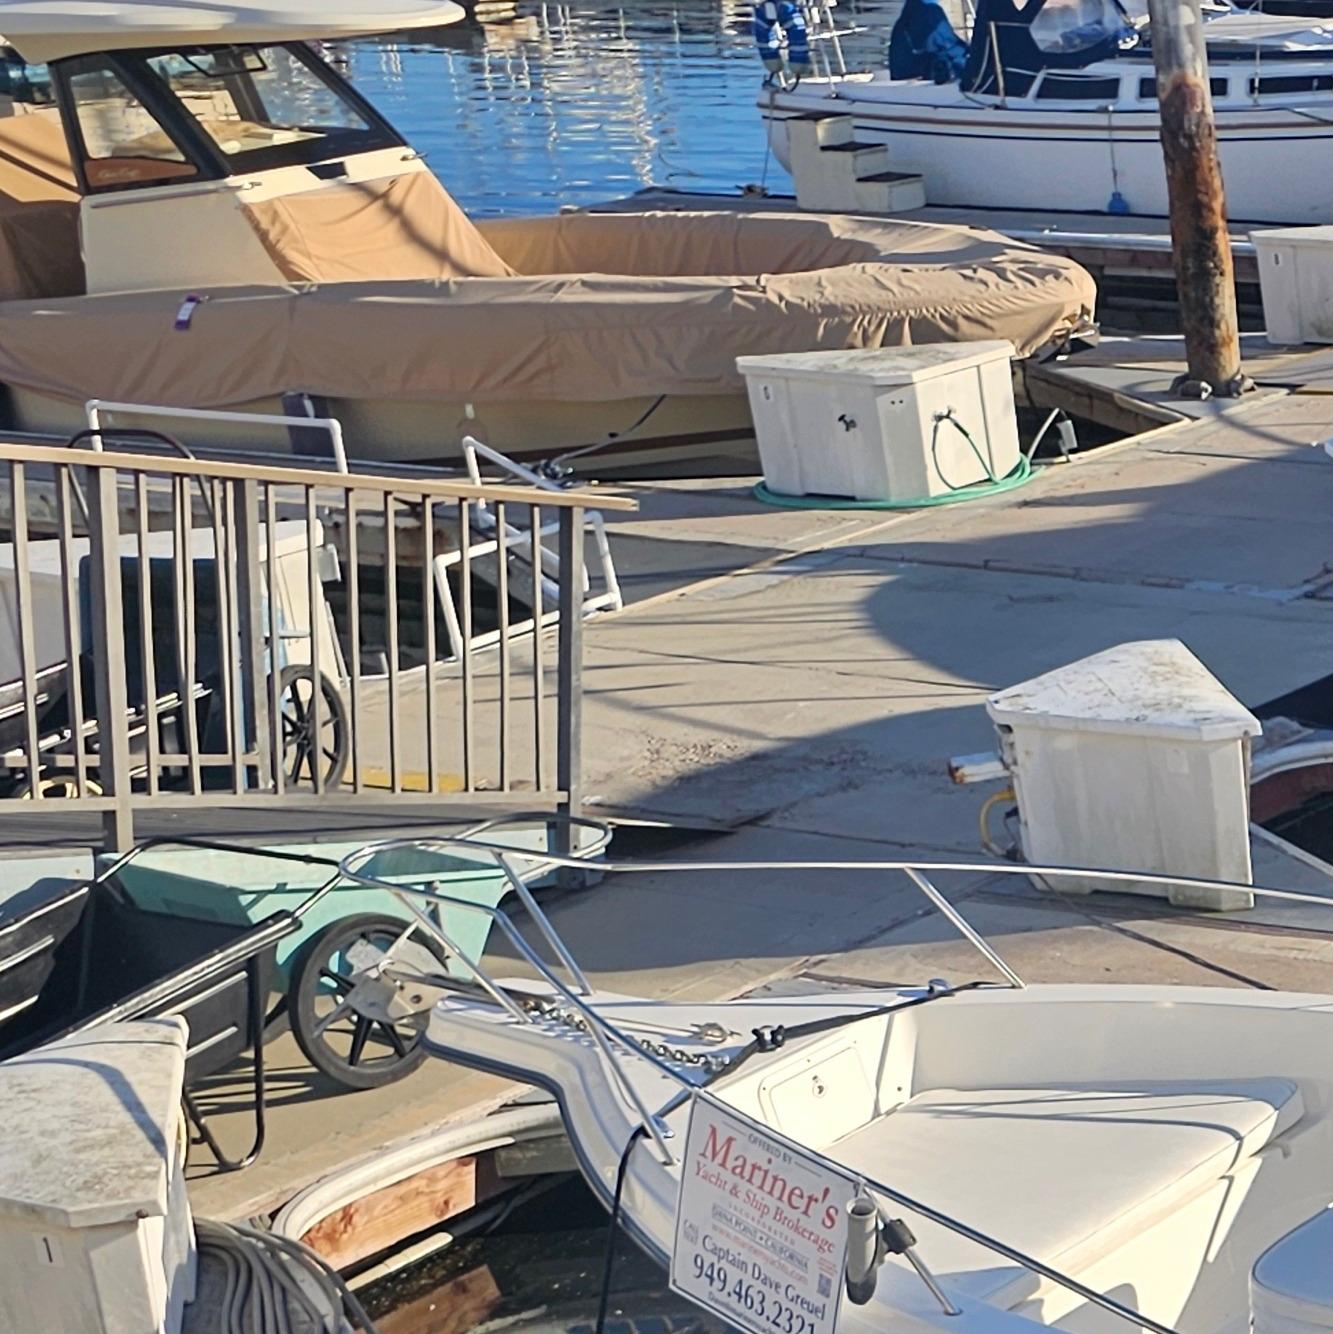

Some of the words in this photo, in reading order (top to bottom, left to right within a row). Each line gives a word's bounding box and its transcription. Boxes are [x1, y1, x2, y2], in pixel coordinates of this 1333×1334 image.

[695, 1160, 727, 1190] Yacht
[729, 1182, 742, 1199] &
[743, 1188, 770, 1218] Ship
[773, 1206, 836, 1254] Brokerage
[699, 1123, 839, 1230] Mariner's
[702, 1234, 748, 1274] Captain
[751, 1262, 782, 1294] Dave
[784, 1284, 826, 1321] Greuel
